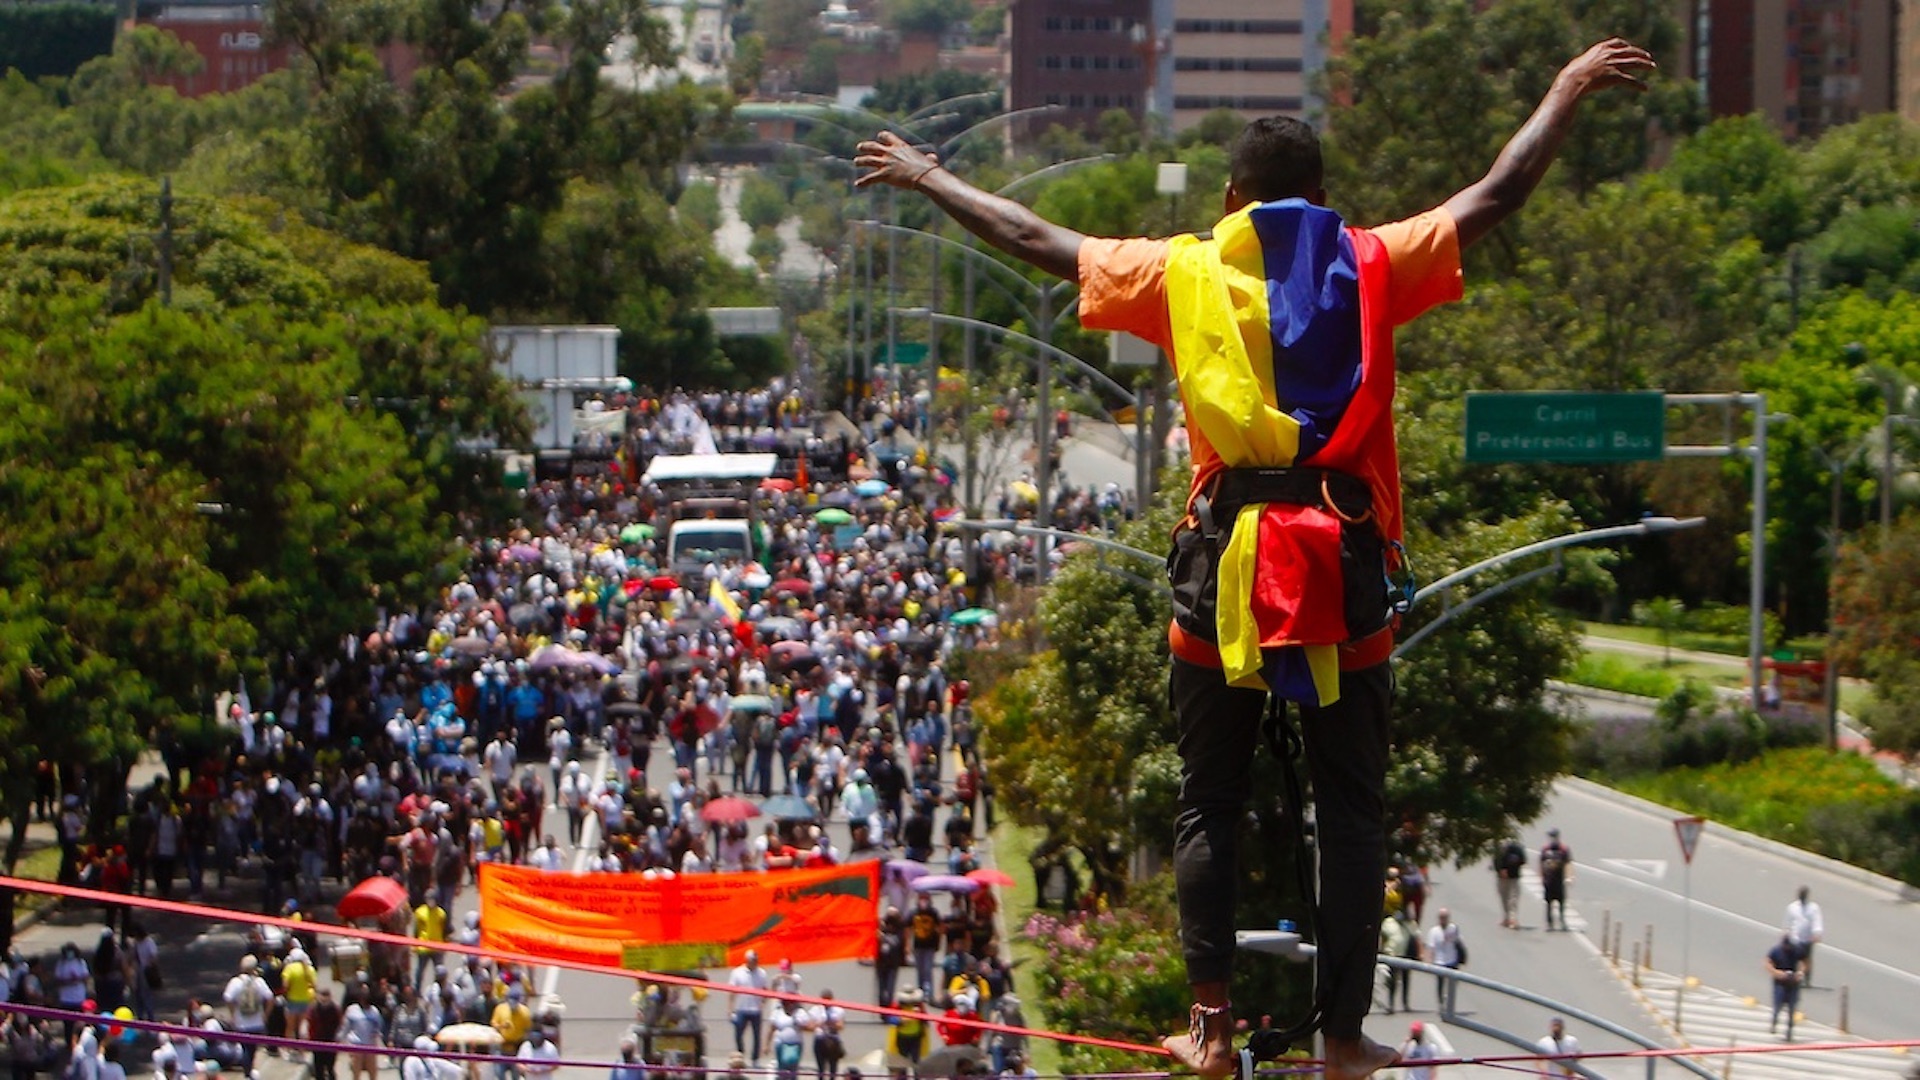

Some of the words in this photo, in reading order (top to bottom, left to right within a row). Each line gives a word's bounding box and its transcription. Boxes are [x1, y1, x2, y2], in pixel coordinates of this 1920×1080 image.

[1536, 404, 1596, 422] Carril
[1476, 431, 1603, 449] Preferencial
[1612, 431, 1652, 449] Bus
